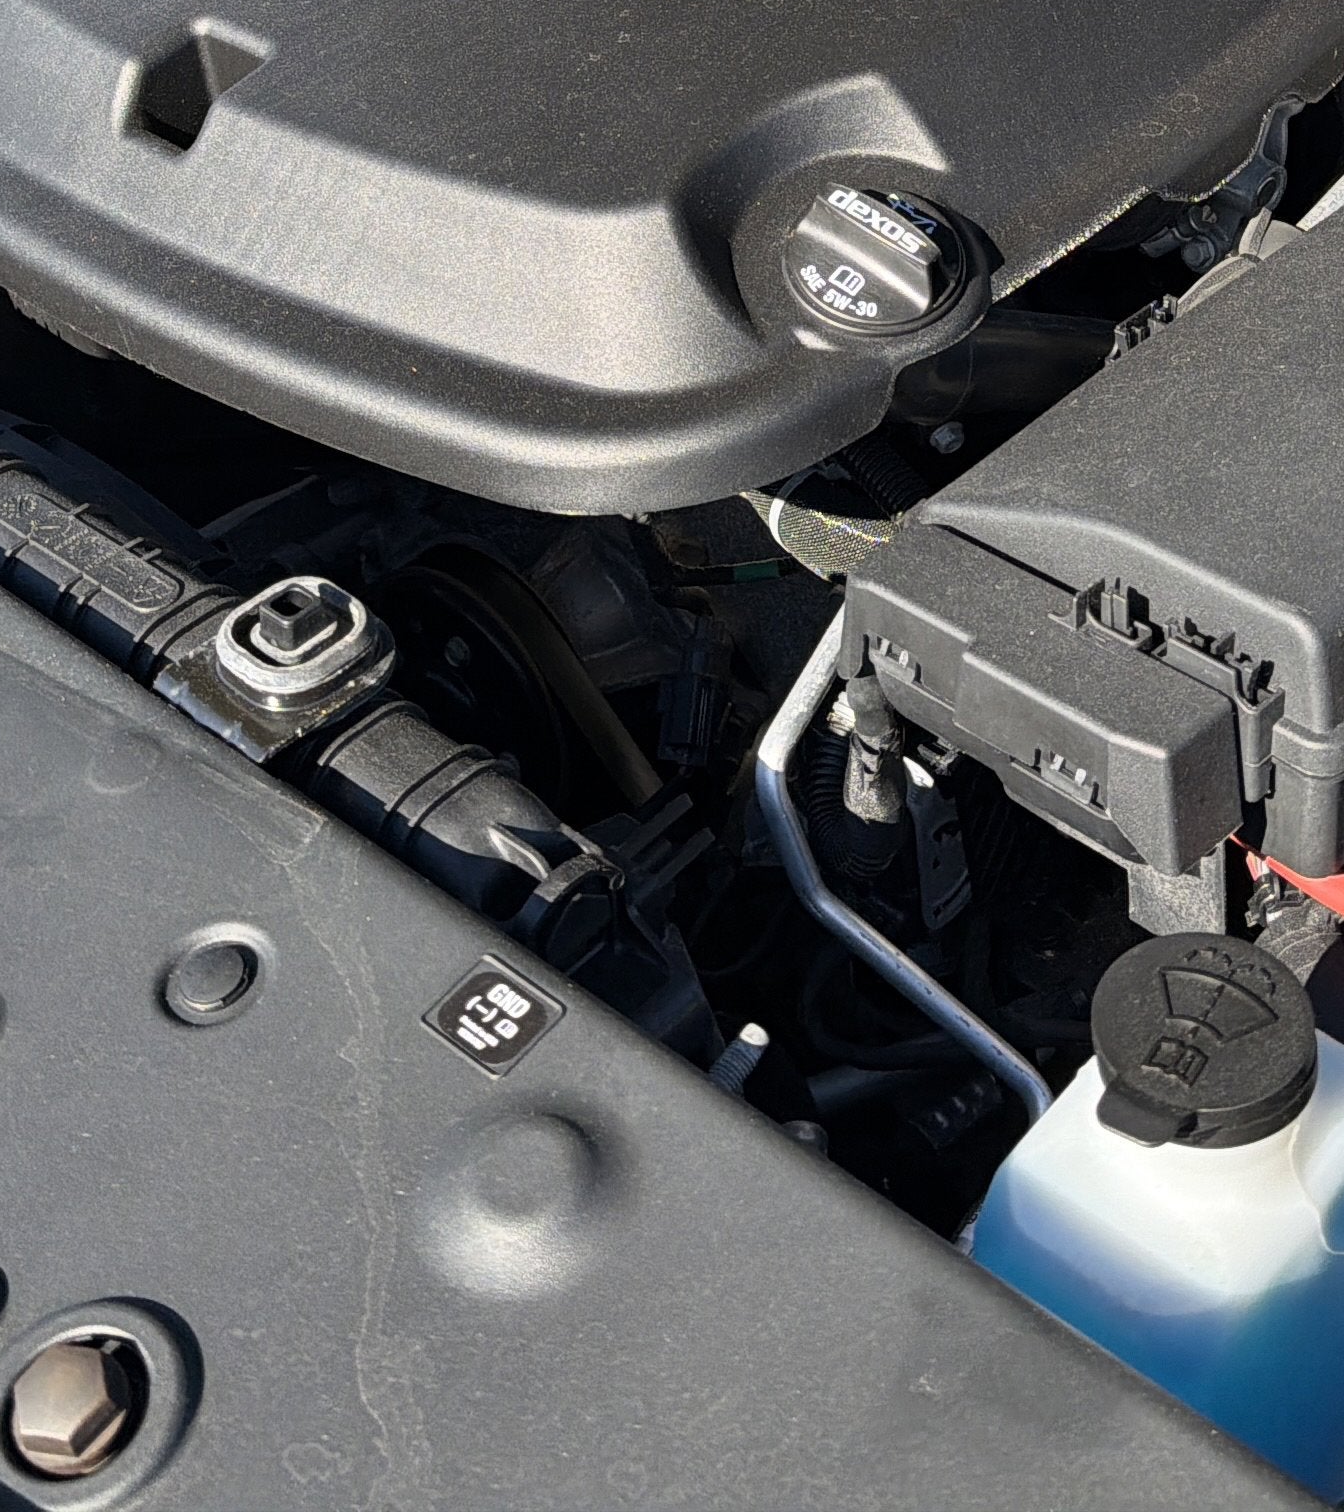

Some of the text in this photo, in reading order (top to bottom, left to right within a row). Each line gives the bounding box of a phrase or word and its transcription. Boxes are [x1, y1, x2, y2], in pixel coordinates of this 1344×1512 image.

[827, 190, 926, 255] dexos
[800, 264, 878, 317] SAE 5W-30
[487, 984, 531, 1018] GND
